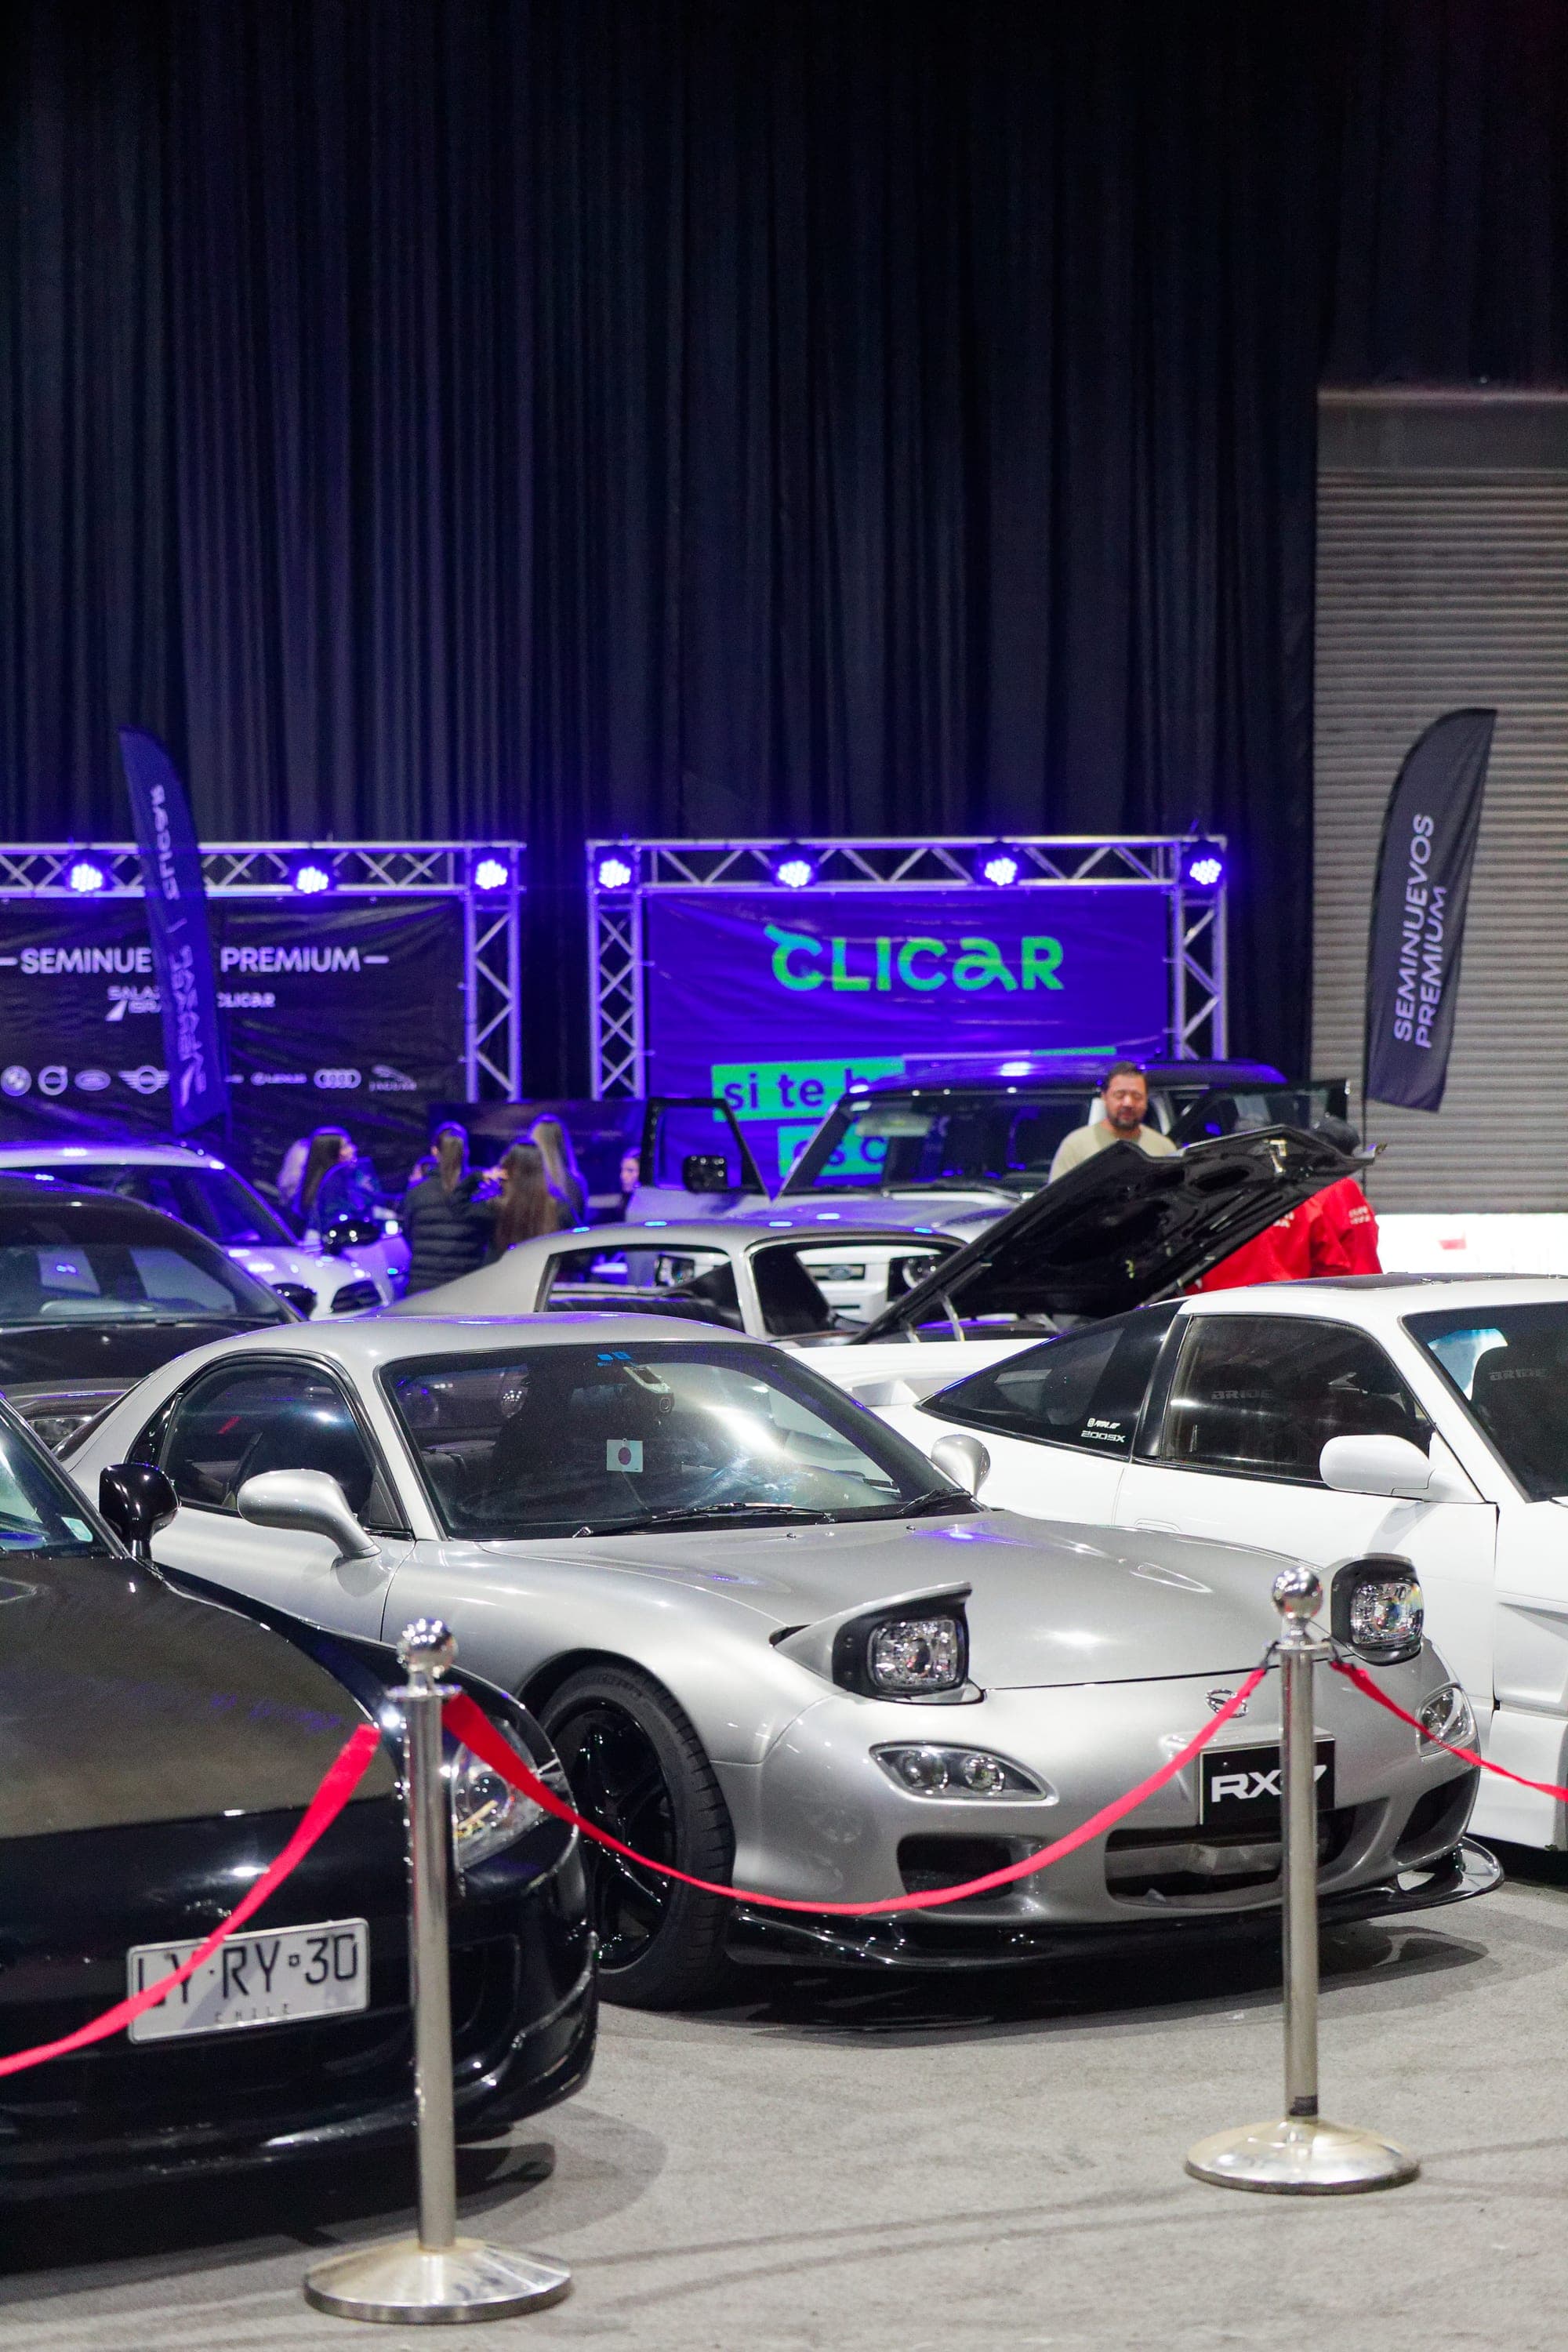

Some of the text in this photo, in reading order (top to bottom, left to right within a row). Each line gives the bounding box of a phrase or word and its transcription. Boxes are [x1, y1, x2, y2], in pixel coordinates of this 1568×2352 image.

[1393, 814, 1434, 1041] SEMINUEVOS
[20, 946, 361, 975] SEMINUE PREMIUM
[1414, 886, 1447, 1049] PREMIUM
[724, 1071, 760, 1112] si
[776, 1073, 824, 1109] te
[1080, 1430, 1126, 1443] 200SX
